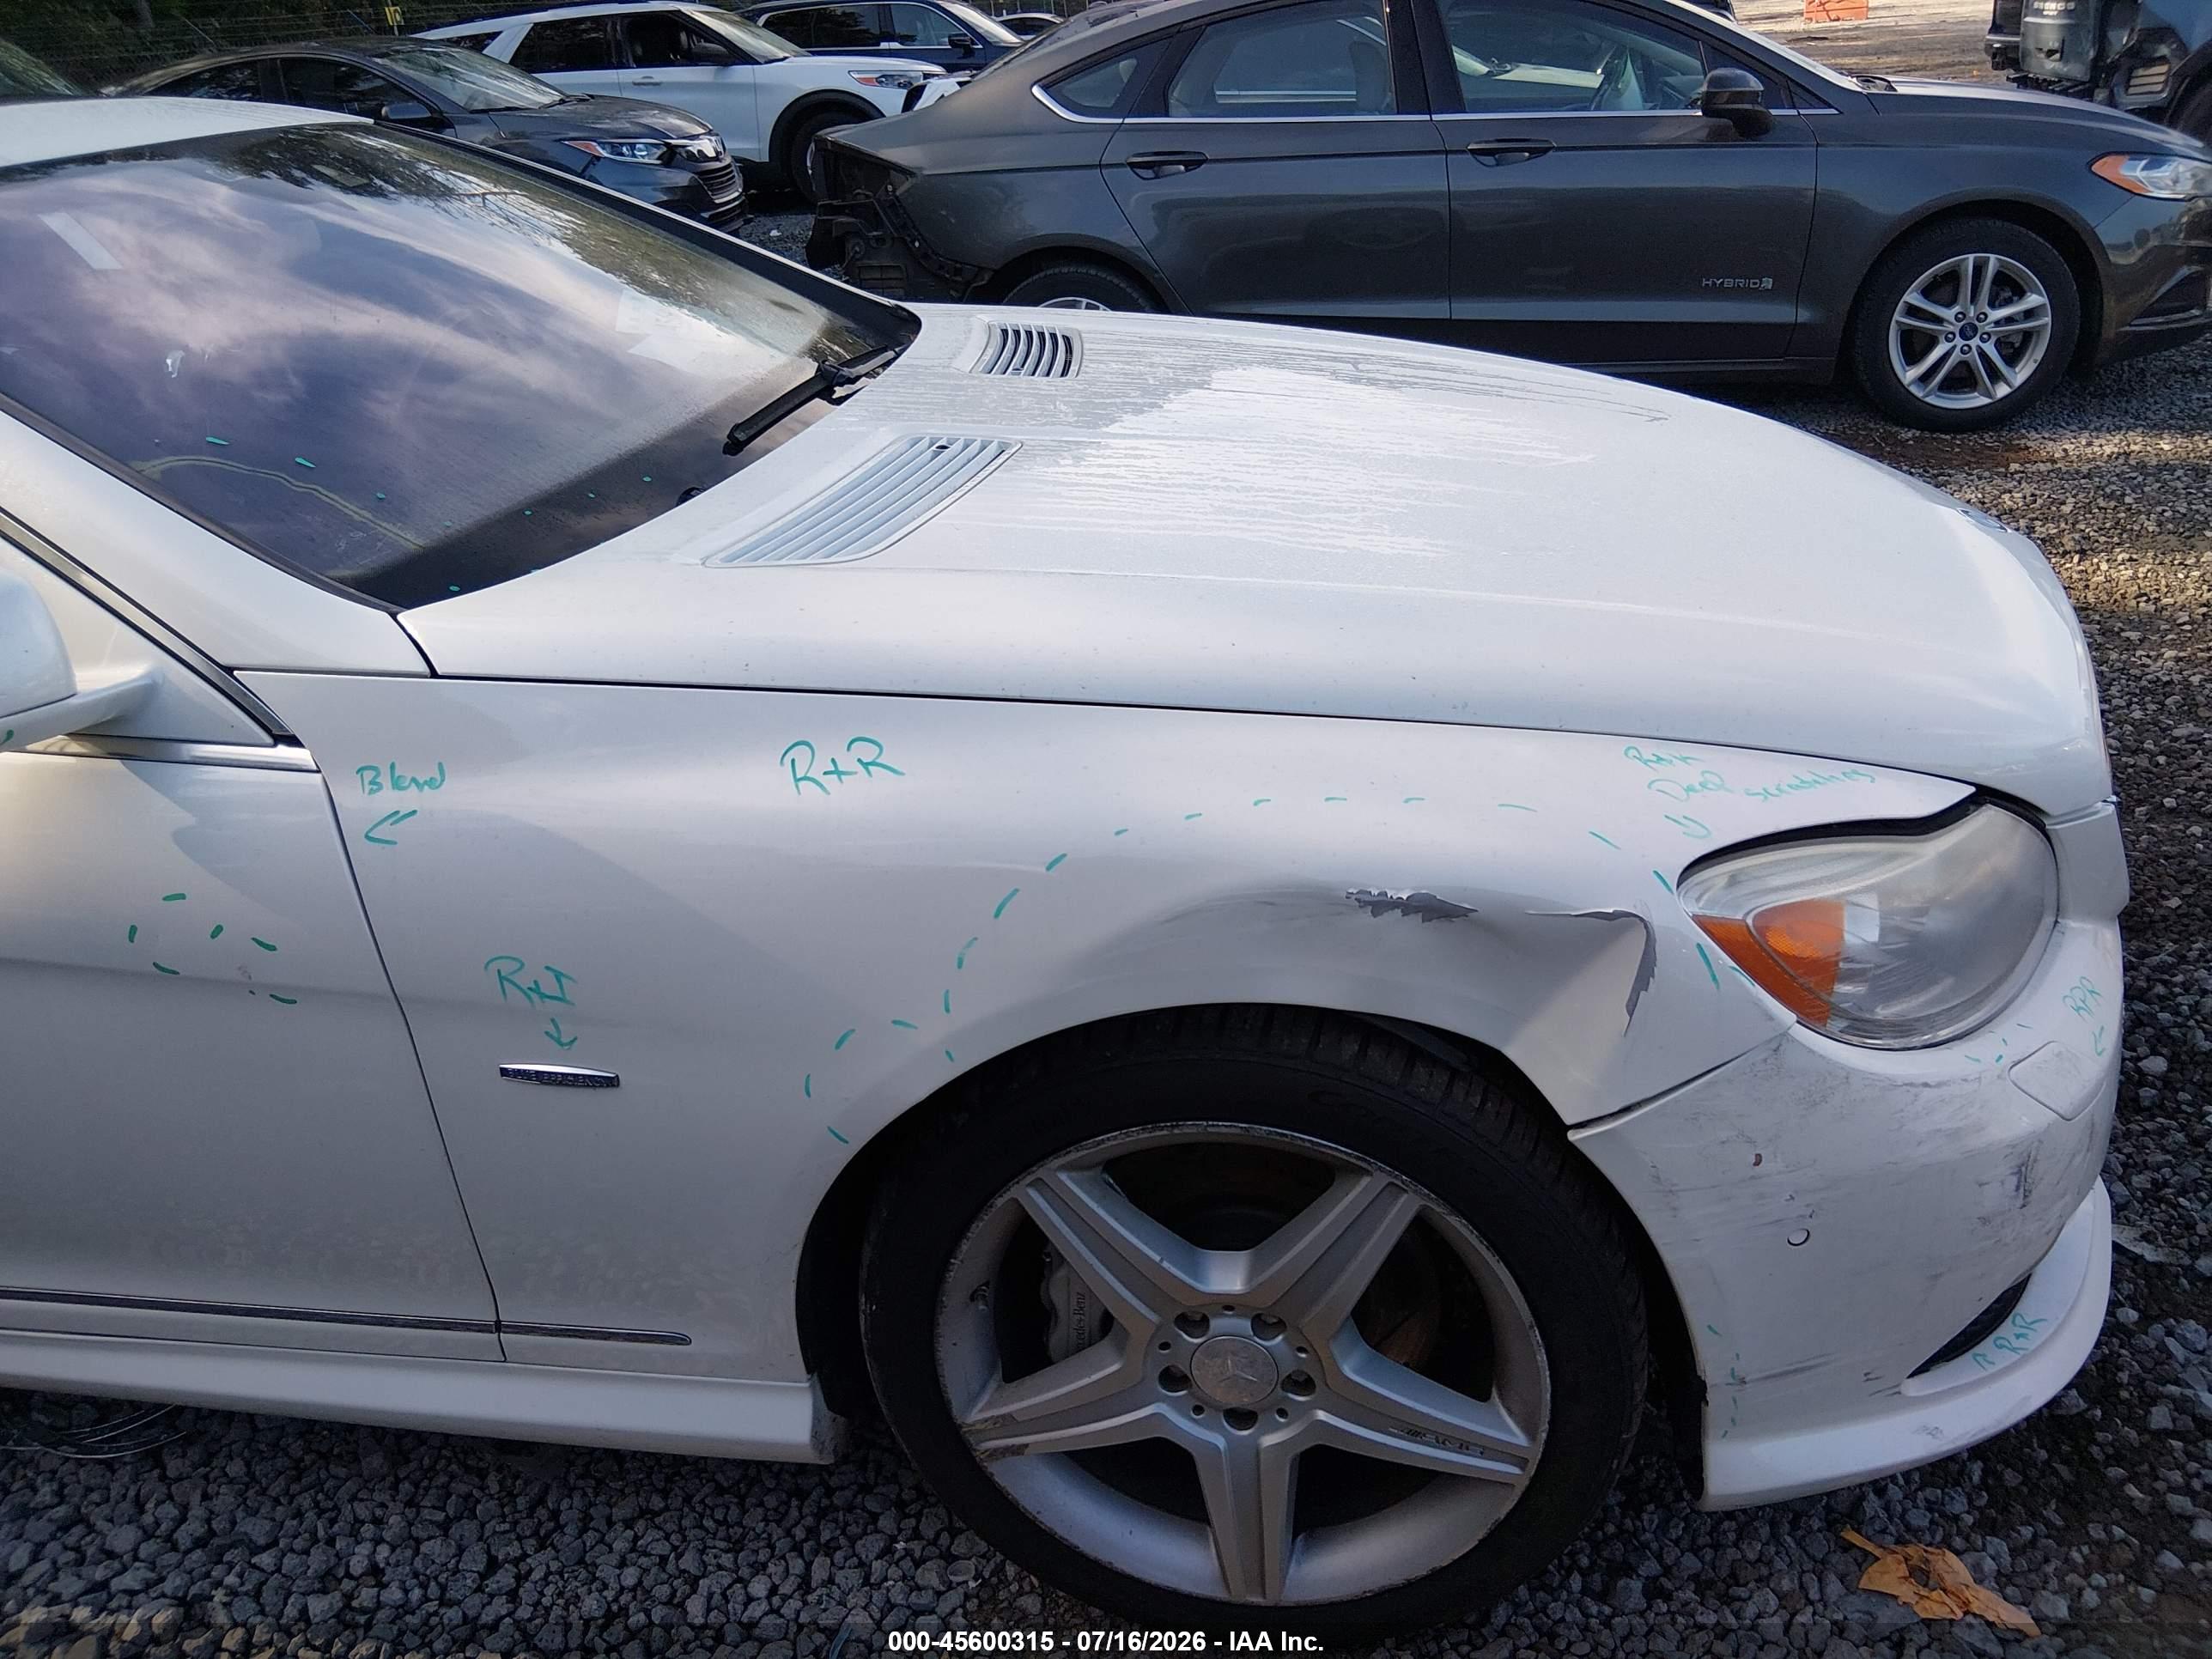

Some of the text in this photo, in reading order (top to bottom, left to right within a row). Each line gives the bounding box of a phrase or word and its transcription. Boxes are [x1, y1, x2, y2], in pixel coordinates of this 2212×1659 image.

[1702, 277, 1760, 289] HYBRID
[356, 761, 446, 795] Blend
[780, 736, 906, 795] R+R
